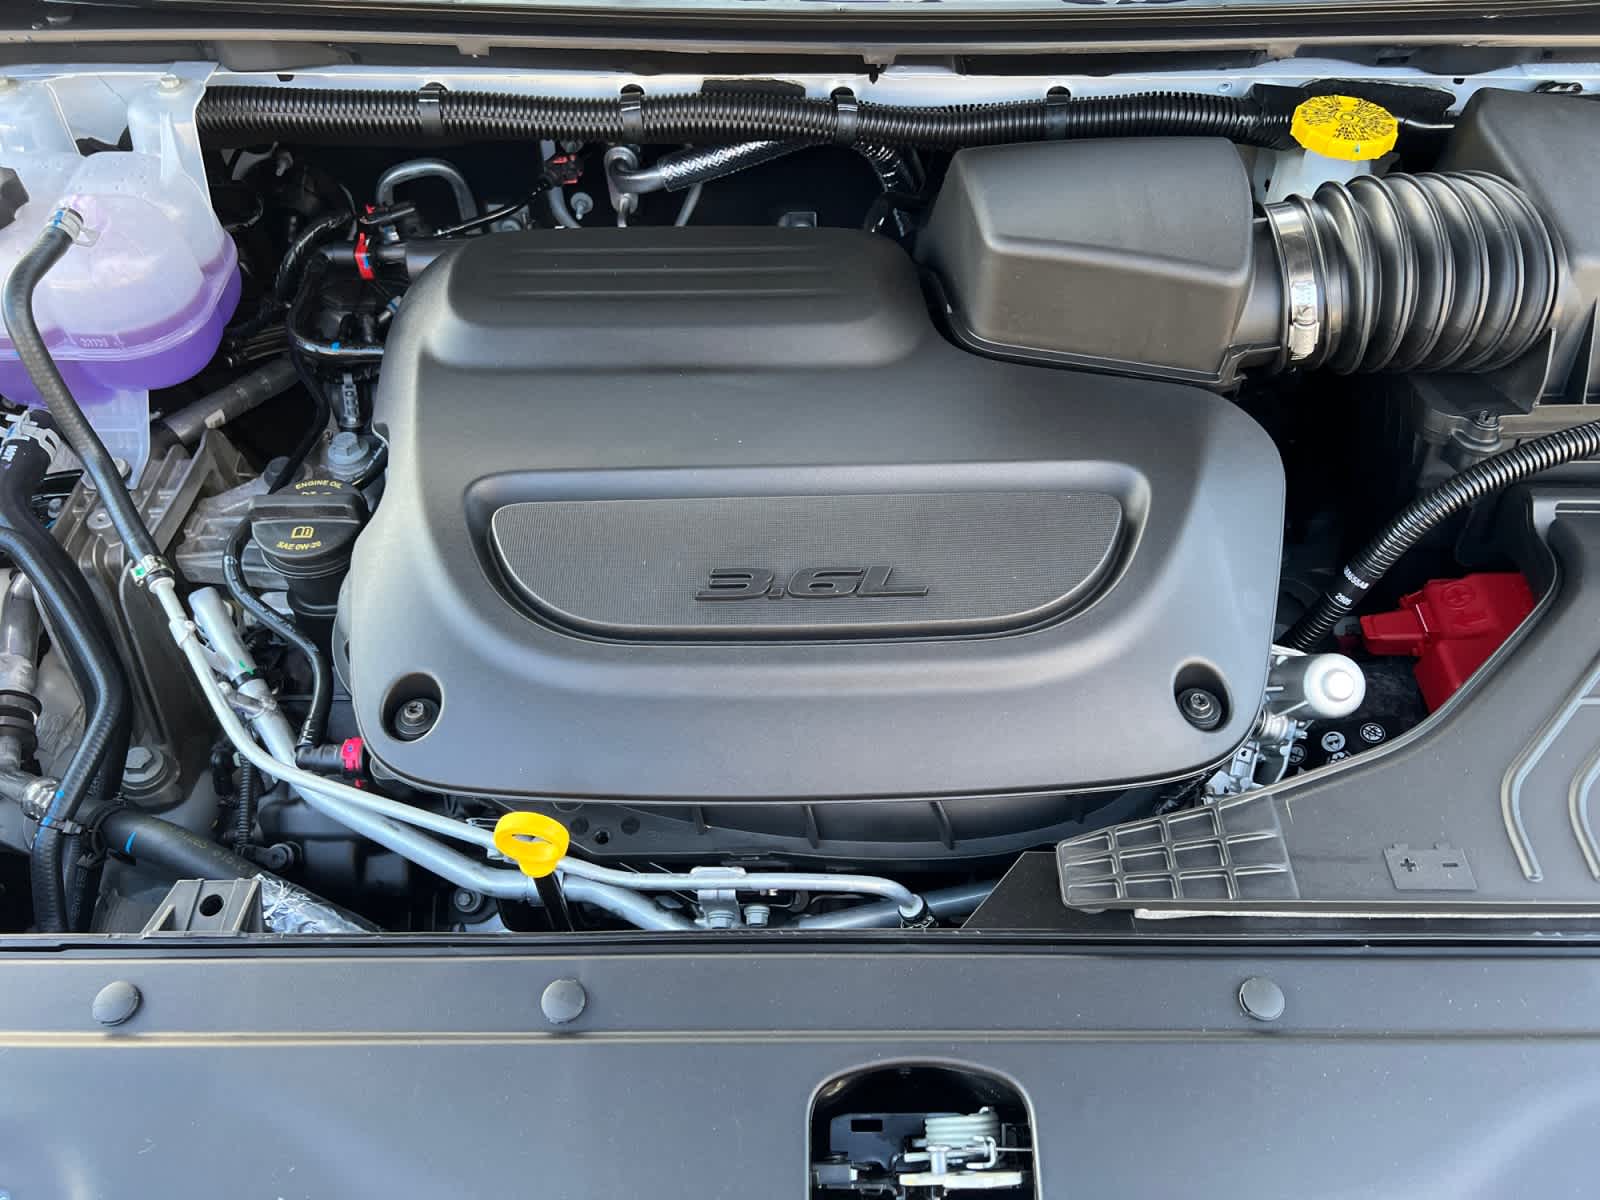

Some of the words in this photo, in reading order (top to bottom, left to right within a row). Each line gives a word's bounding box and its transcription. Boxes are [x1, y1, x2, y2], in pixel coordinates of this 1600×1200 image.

[295, 480, 329, 490] ENGINE
[276, 541, 294, 550] SAE
[696, 566, 928, 600] 3.6L
